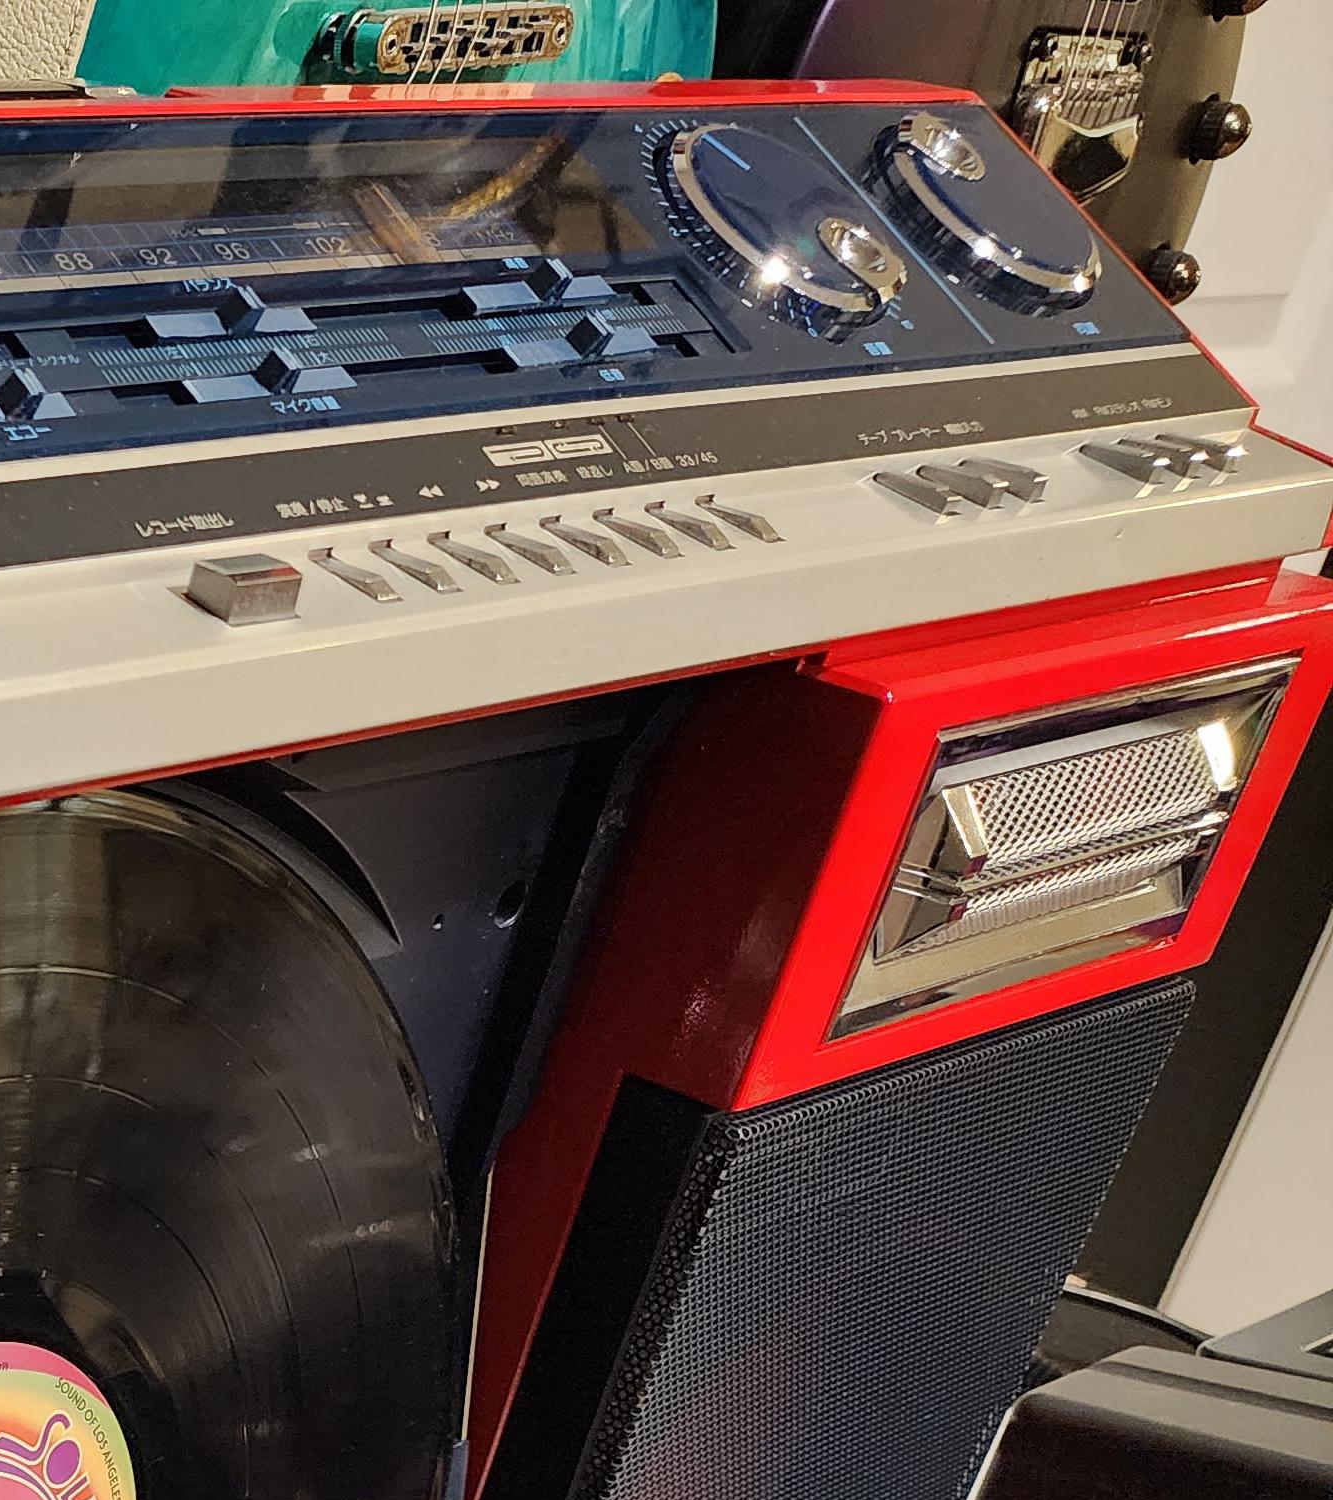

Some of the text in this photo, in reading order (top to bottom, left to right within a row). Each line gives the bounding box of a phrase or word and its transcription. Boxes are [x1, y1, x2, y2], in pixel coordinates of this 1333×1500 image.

[54, 252, 94, 272] 88
[139, 247, 178, 267] 92
[214, 242, 251, 261] 96
[304, 235, 353, 256] 102
[2, 424, 53, 441] エコー
[675, 451, 720, 469] 33/45
[55, 1376, 86, 1412] SOUND
[84, 1408, 98, 1427] OF
[92, 1423, 109, 1450] LOS
